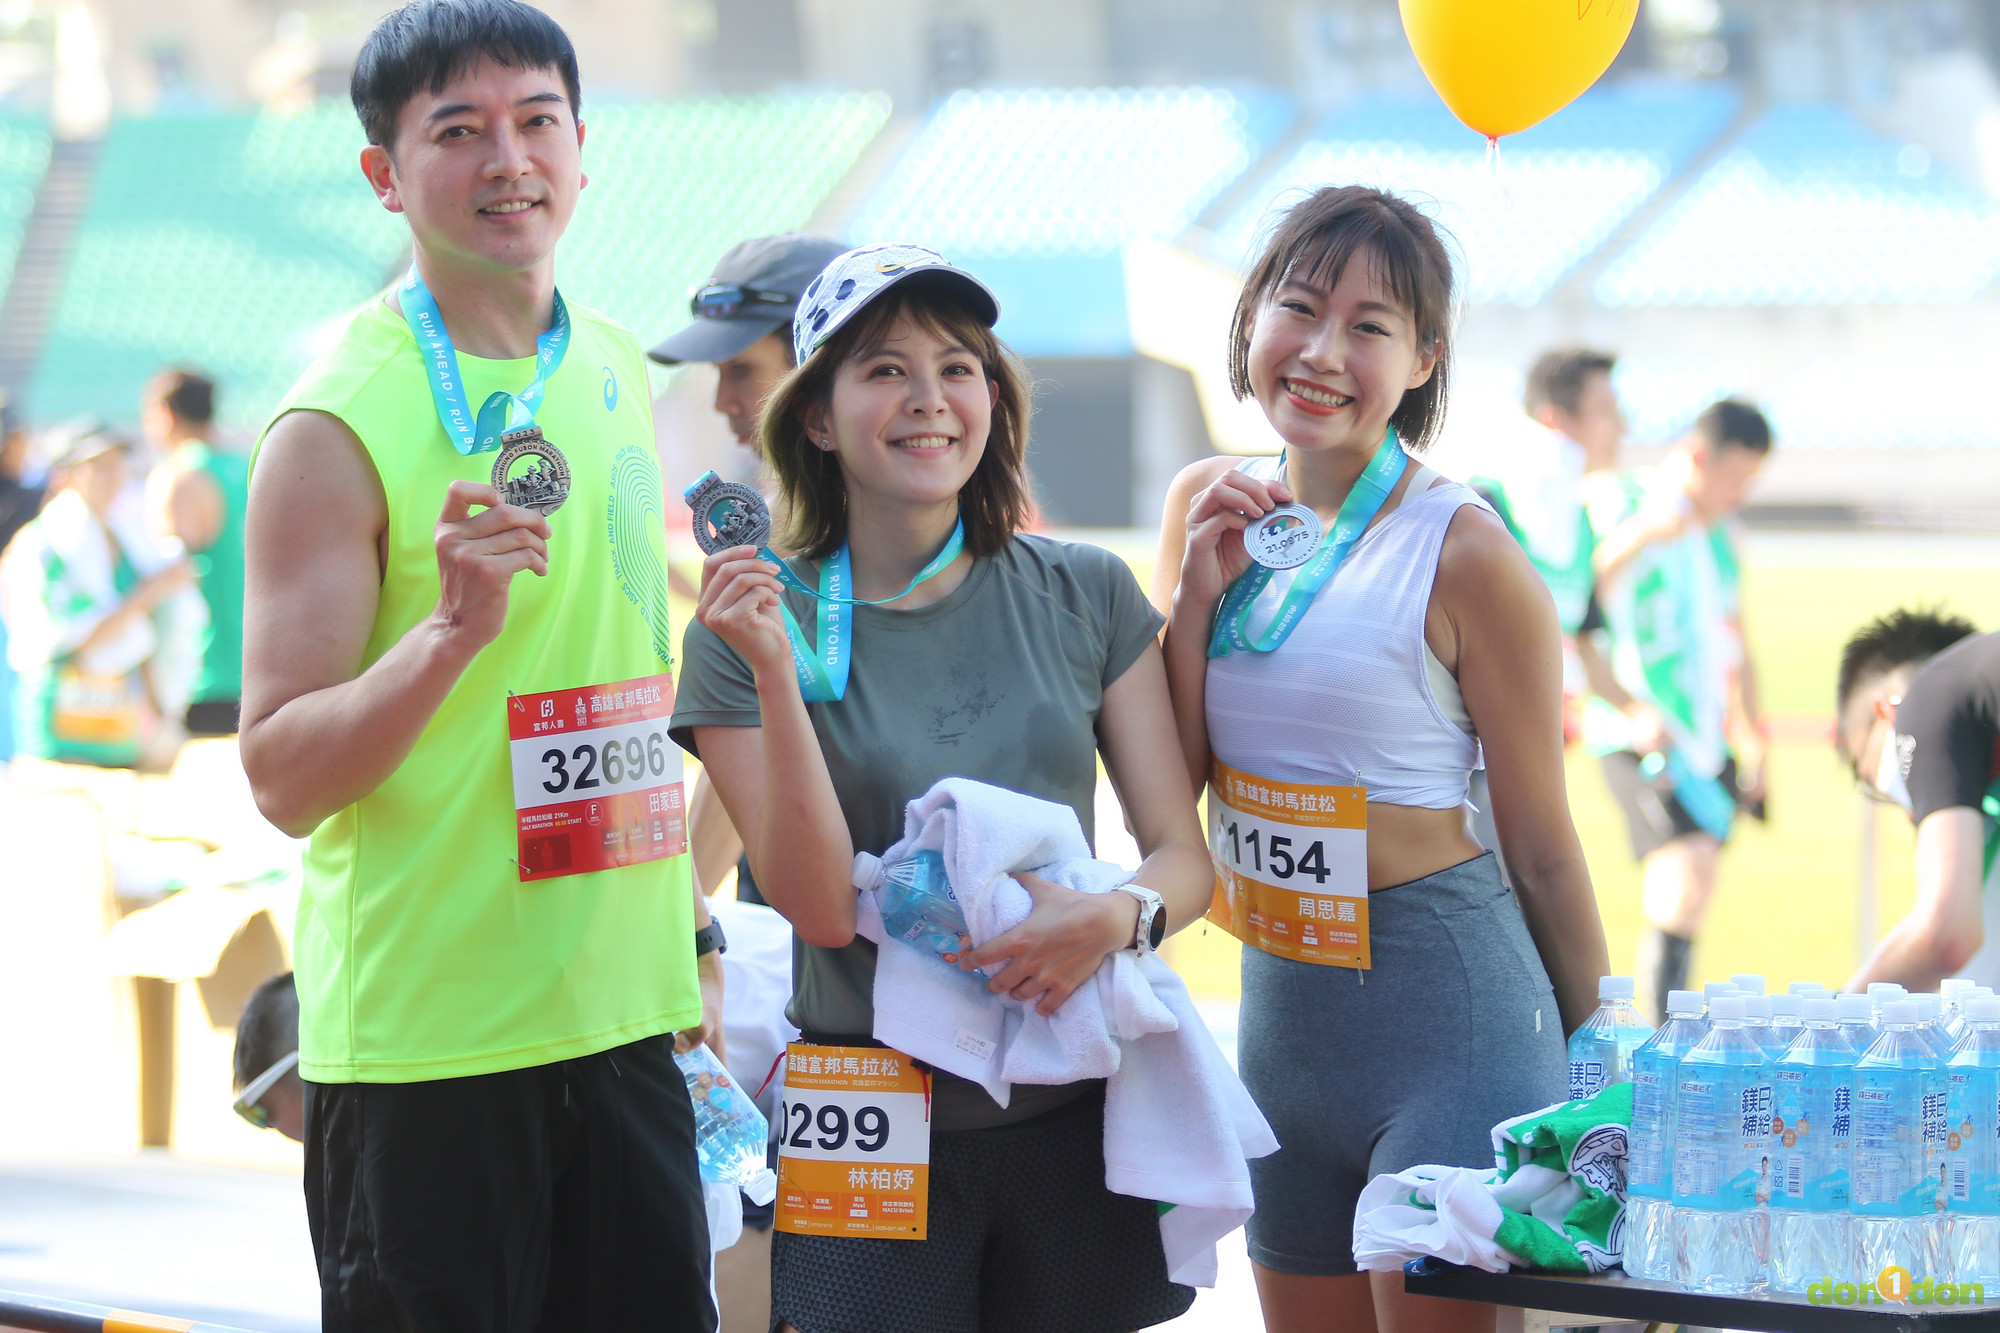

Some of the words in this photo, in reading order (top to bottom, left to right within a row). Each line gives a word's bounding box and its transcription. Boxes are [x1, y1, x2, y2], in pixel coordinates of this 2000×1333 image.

[417, 311, 437, 338] RUN
[430, 341, 453, 392] AHEAD
[449, 408, 469, 433] RUN
[508, 429, 535, 440] 2023
[497, 453, 514, 490] KAOHSIUNG
[514, 444, 538, 454] FUBON
[539, 444, 565, 476] MARATHON
[690, 478, 712, 500] 2023
[704, 490, 722, 509] FUBON
[722, 488, 758, 506] MARATHON
[607, 495, 615, 521] FIELD
[608, 523, 616, 544] AND
[697, 510, 713, 549] KAOHSIUNG
[1264, 530, 1309, 555] 21.0975
[611, 548, 624, 581] TRACK
[621, 582, 639, 605] ASICS
[827, 573, 841, 602] RUN
[827, 603, 840, 666] BEYOND
[1230, 616, 1245, 648] RUN
[590, 686, 662, 714] 高雄富邦馬拉松
[541, 732, 665, 794] 32696
[1235, 779, 1336, 813] 高雄富邦馬拉松
[554, 811, 569, 819] 21Km
[591, 804, 597, 815] F
[532, 822, 554, 830] MARATHON
[1228, 821, 1331, 884] 1154
[1298, 897, 1356, 923] 周思嘉
[788, 1054, 899, 1077] 高雄富邦馬拉松
[1742, 1086, 1772, 1114] 鎂日
[1922, 1092, 1947, 1120] 鎂日
[1741, 1113, 1772, 1137] 補給
[1922, 1119, 1948, 1144] 補給
[848, 1167, 914, 1191] 林柏妤
